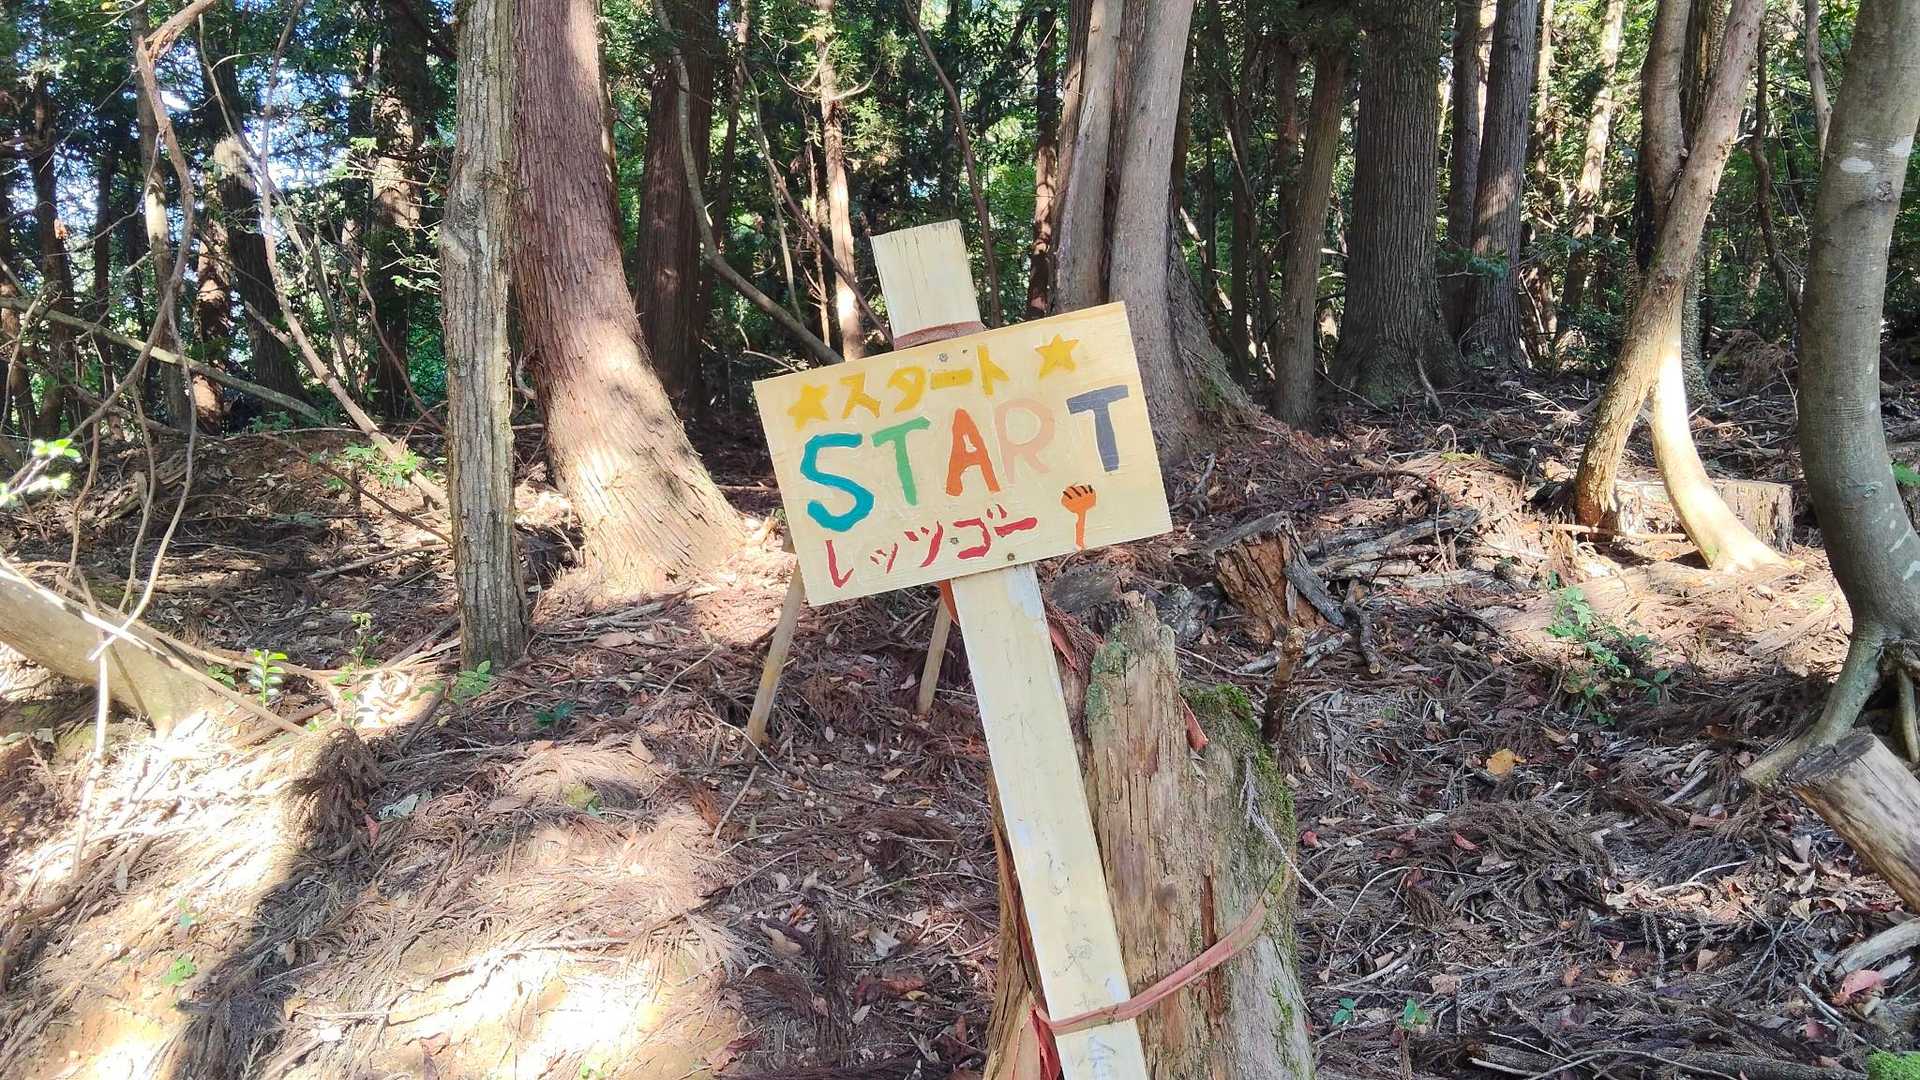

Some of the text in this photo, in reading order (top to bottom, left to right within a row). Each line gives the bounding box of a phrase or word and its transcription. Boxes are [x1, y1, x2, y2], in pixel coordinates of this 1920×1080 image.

[839, 344, 1010, 419] スタート
[800, 384, 1129, 533] START
[824, 503, 1038, 588] レッツゴー
